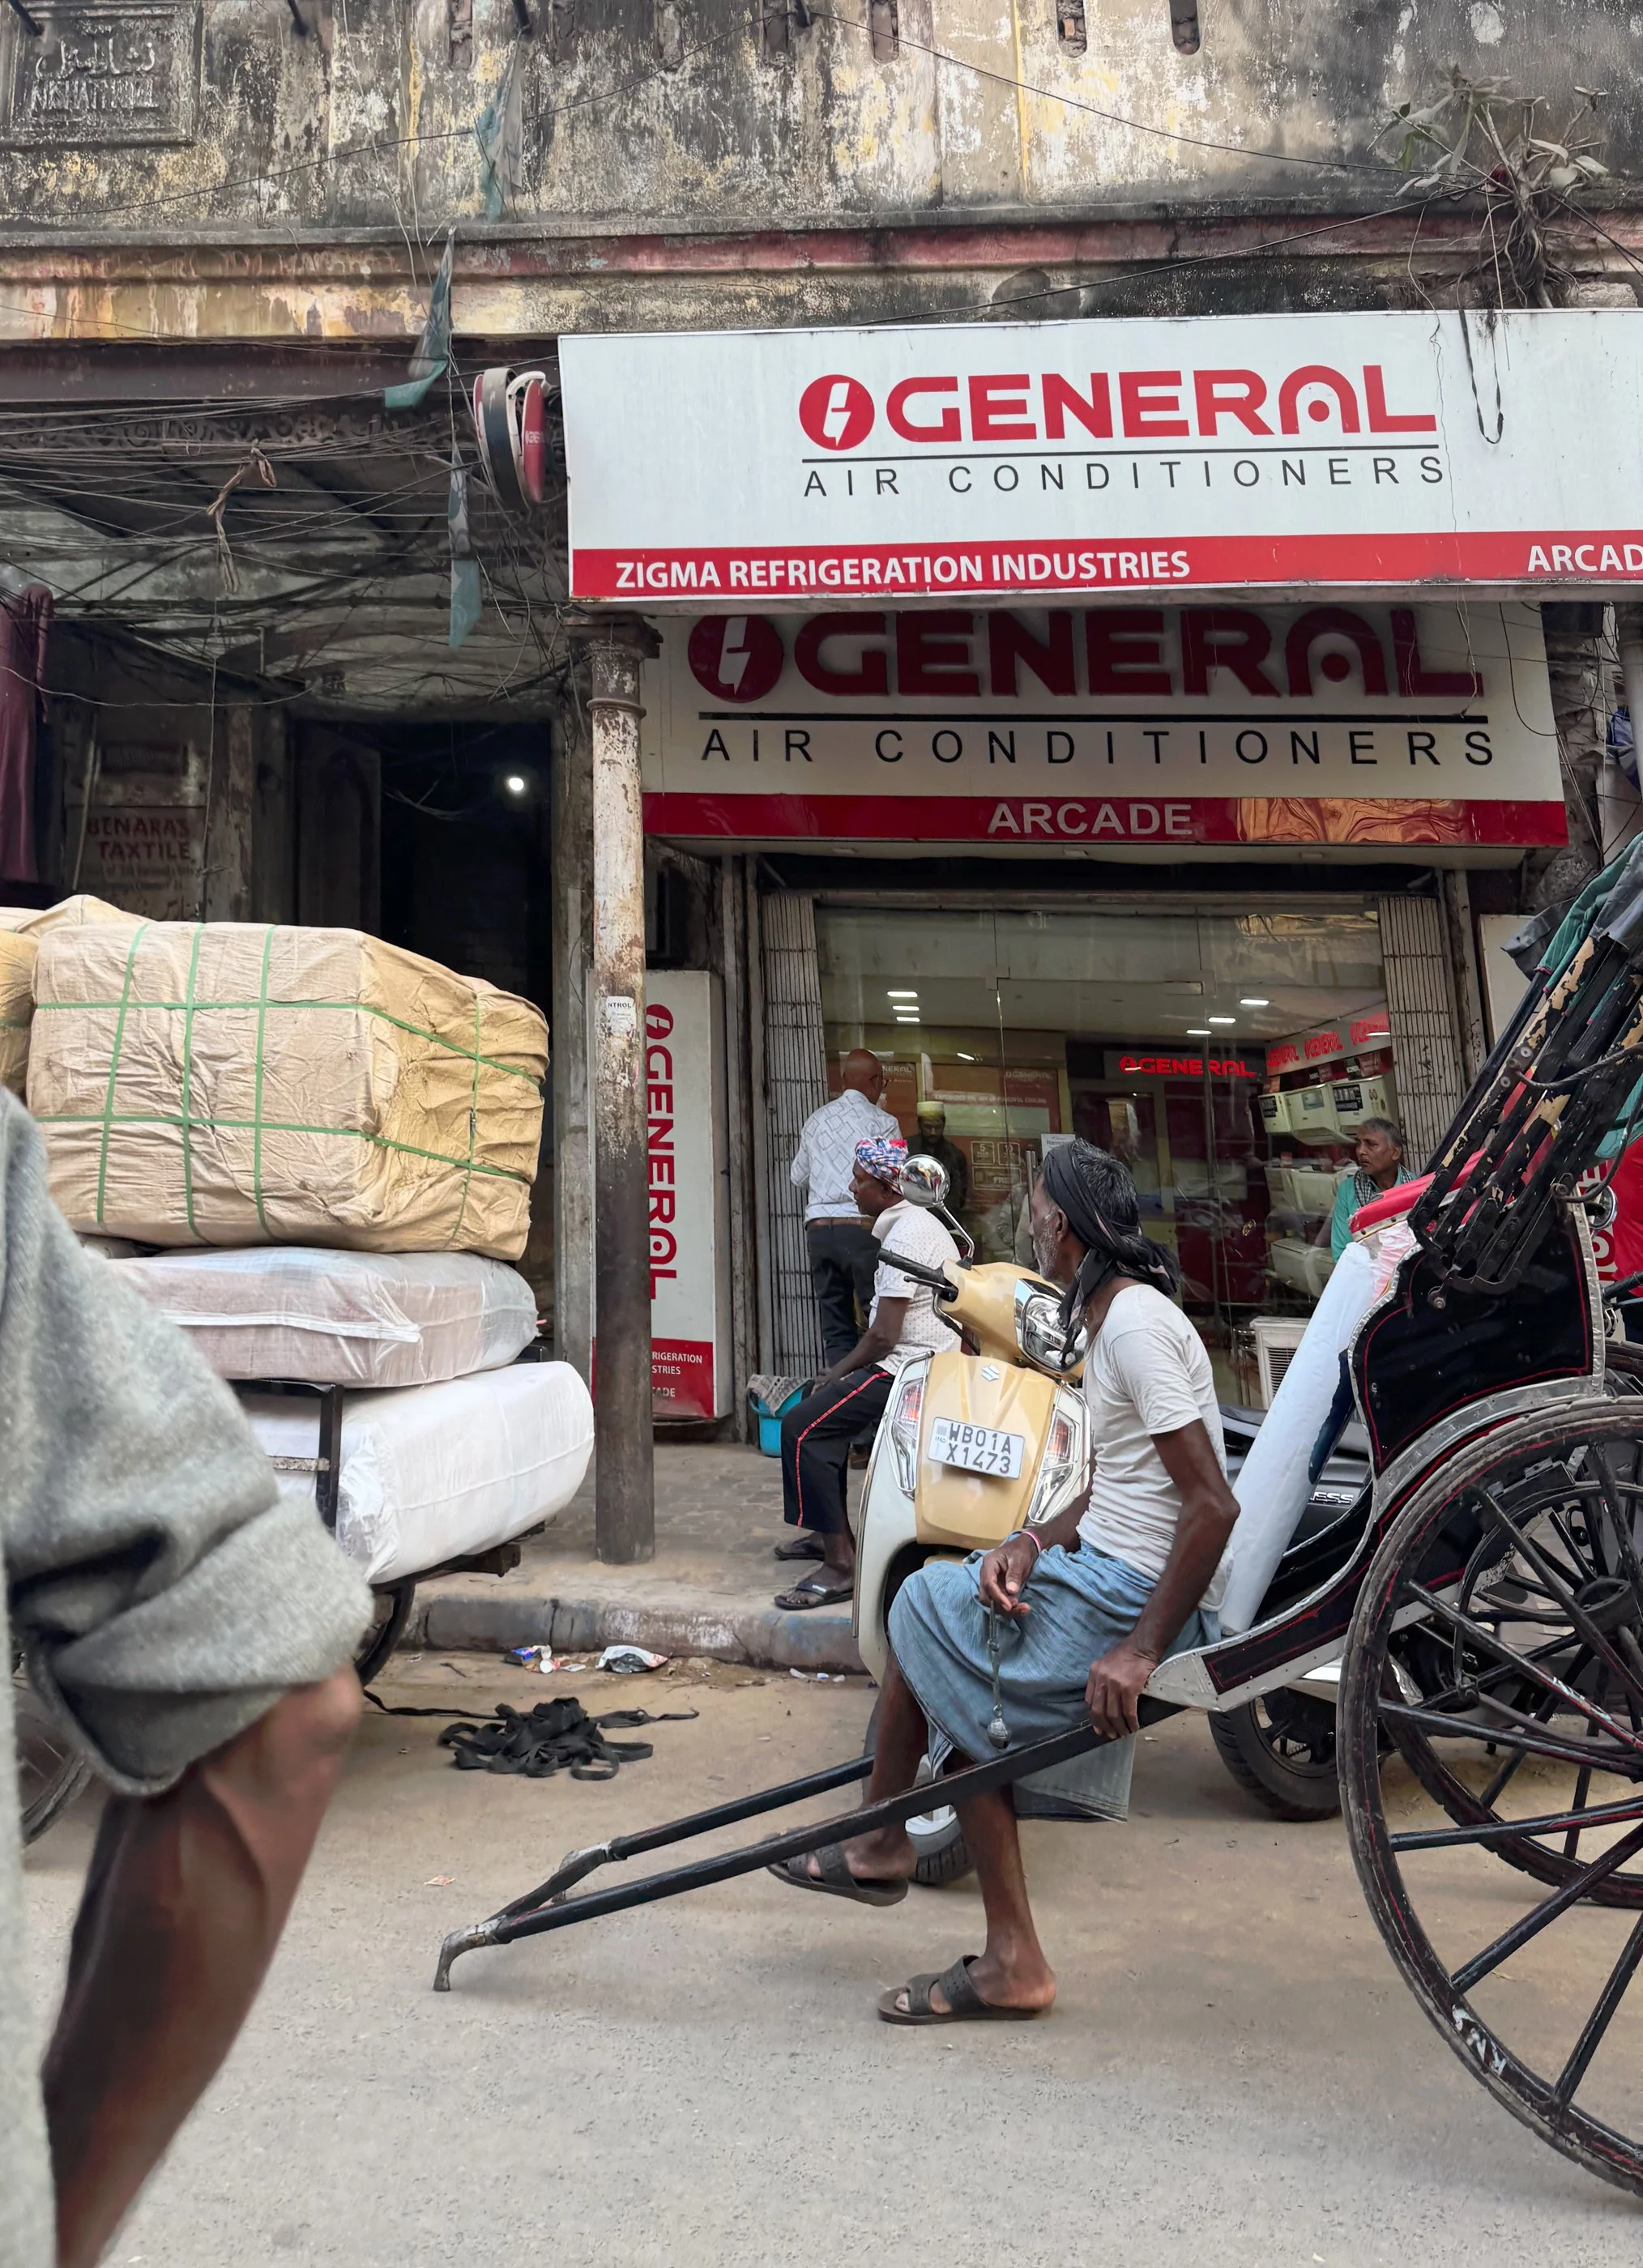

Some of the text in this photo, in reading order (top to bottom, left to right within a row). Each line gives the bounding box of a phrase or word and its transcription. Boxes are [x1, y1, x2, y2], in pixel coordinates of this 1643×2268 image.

[886, 364, 1437, 443] GENERAL
[804, 456, 1444, 497] AIR CONDITIONERS
[616, 551, 1191, 589] ZIGMA REFRIGERATION INDUSTRIES
[1527, 544, 1643, 572] ARCAD
[794, 606, 1484, 698] GENERAL
[701, 728, 1493, 765] AIR CONDITIONERS
[987, 802, 1193, 836] ARCADE
[97, 841, 190, 861] TAXTILE
[881, 1064, 912, 1073] NERAL
[1139, 1056, 1256, 1077] GENERAL
[646, 1045, 676, 1300] GENERAL
[651, 1351, 702, 1364] RIGERATION
[651, 1365, 681, 1375] STRIES
[950, 1422, 1011, 1455] WB01A
[946, 1443, 1011, 1474] X1473
[1310, 1491, 1354, 1503] ESS
